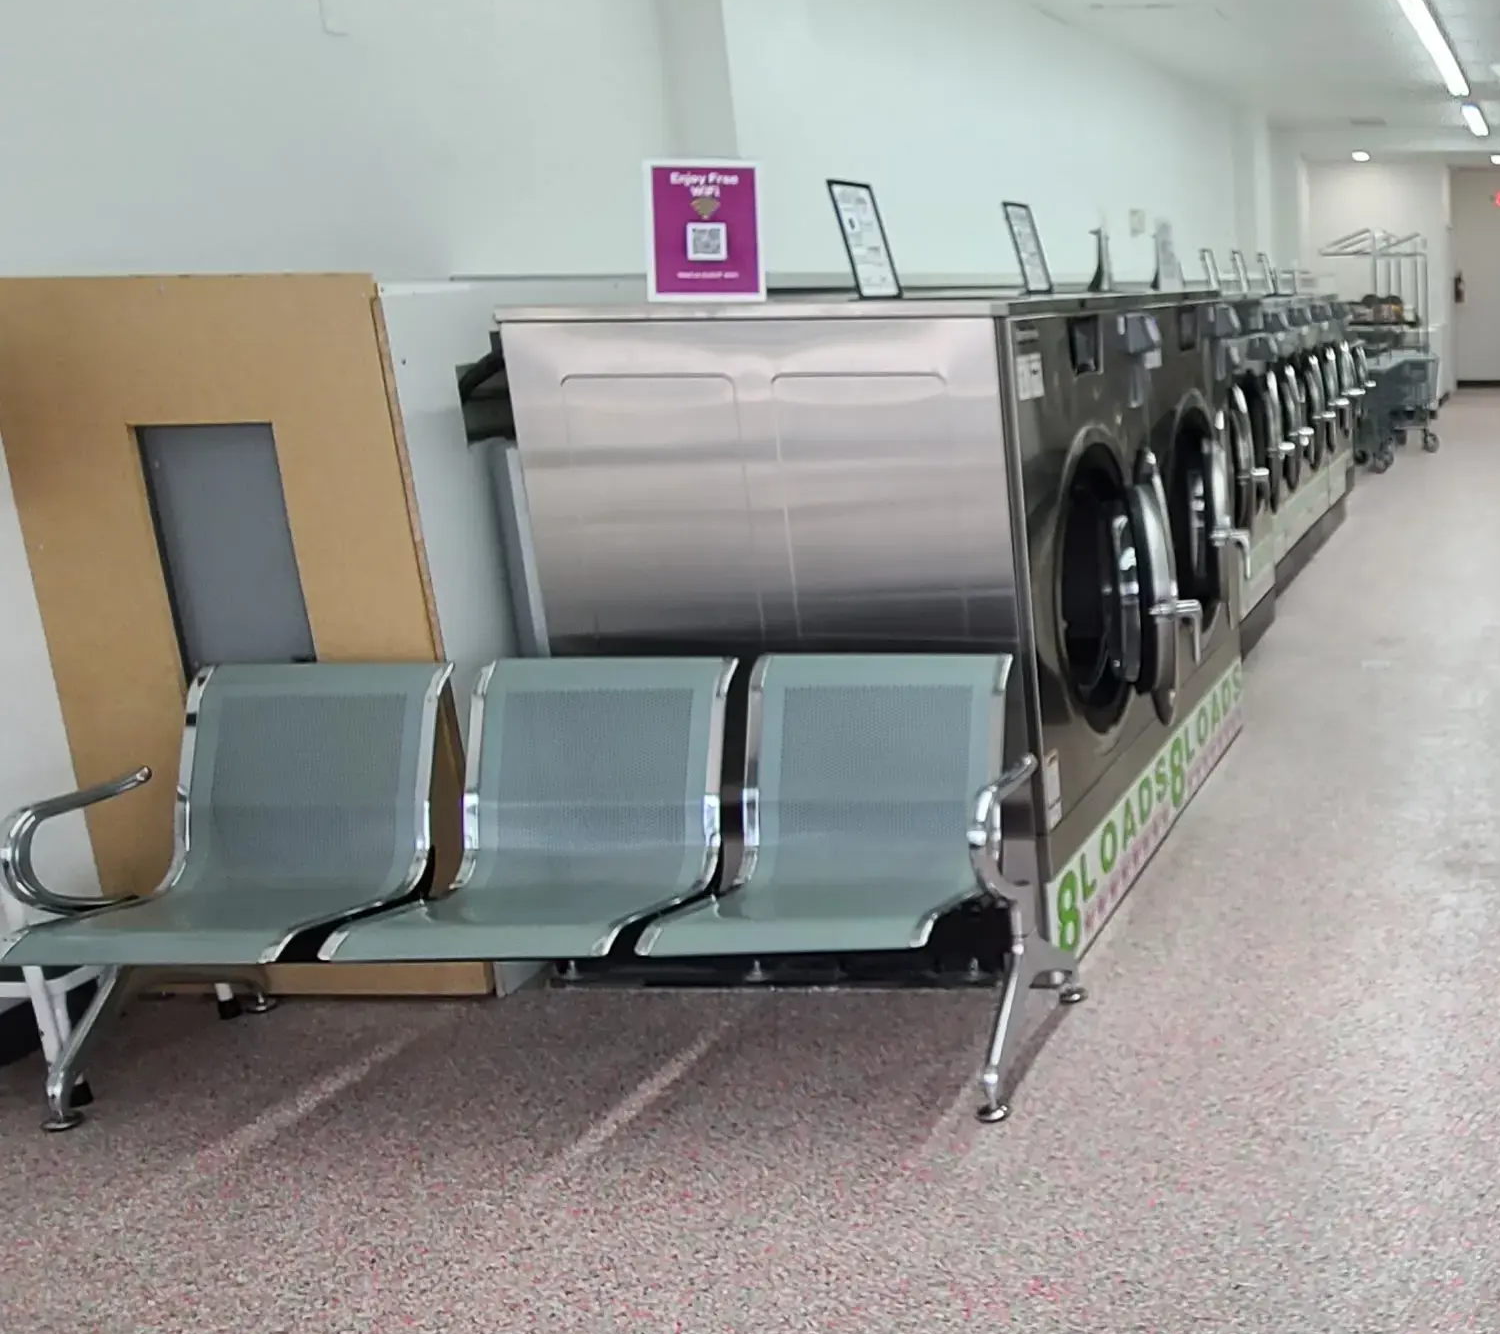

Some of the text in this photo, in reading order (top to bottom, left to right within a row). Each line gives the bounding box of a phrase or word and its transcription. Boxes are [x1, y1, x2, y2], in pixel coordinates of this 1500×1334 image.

[669, 171, 739, 187] Enjoy Free
[1057, 870, 1080, 951] 8
[1079, 756, 1168, 902] LOADS
